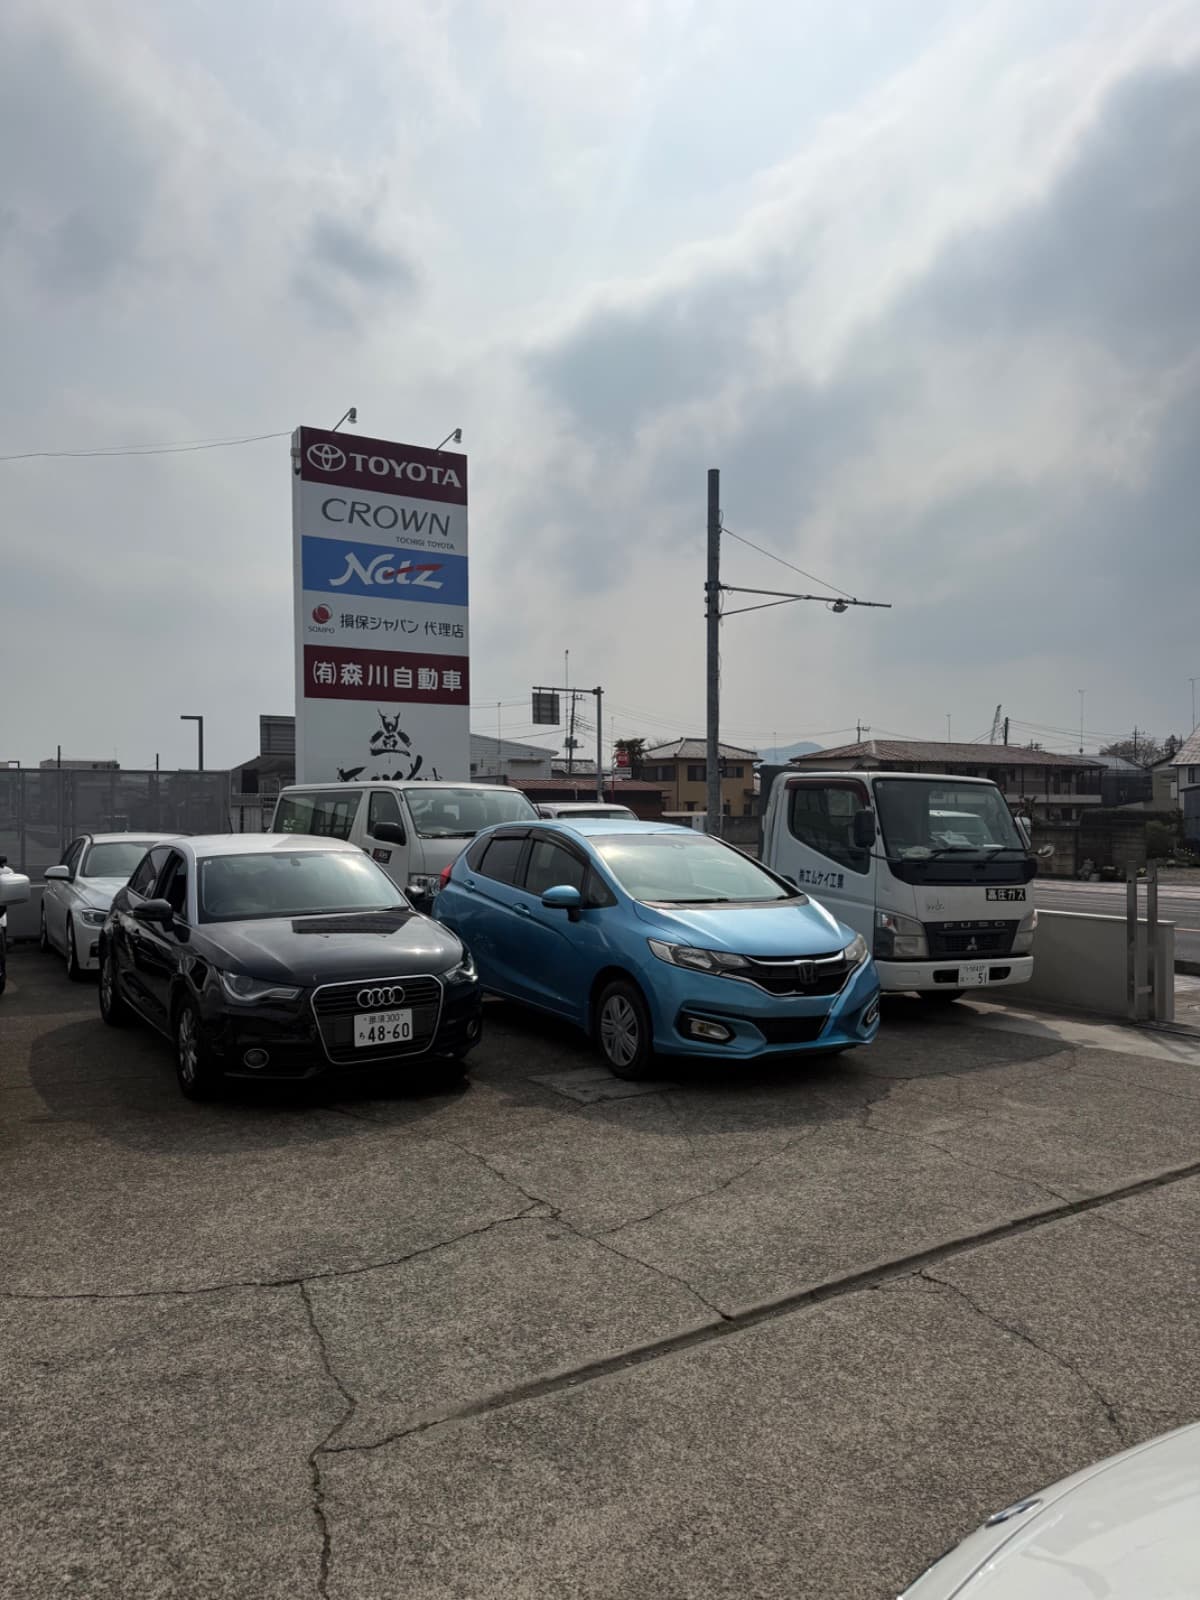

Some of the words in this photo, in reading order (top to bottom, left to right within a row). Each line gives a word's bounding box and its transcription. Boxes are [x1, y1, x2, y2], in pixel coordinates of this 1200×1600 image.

[349, 453, 462, 488] TOYOTA
[321, 498, 450, 537] CROWN
[395, 535, 425, 547] TOCHIGI
[427, 539, 455, 551] TOYOTA
[329, 551, 444, 589] Netz
[308, 625, 335, 634] SOMPO
[424, 620, 464, 639] 代理店
[987, 889, 1025, 901] 高圧ガス
[943, 920, 1006, 929] FUSO
[368, 1022, 409, 1042] 48-60
